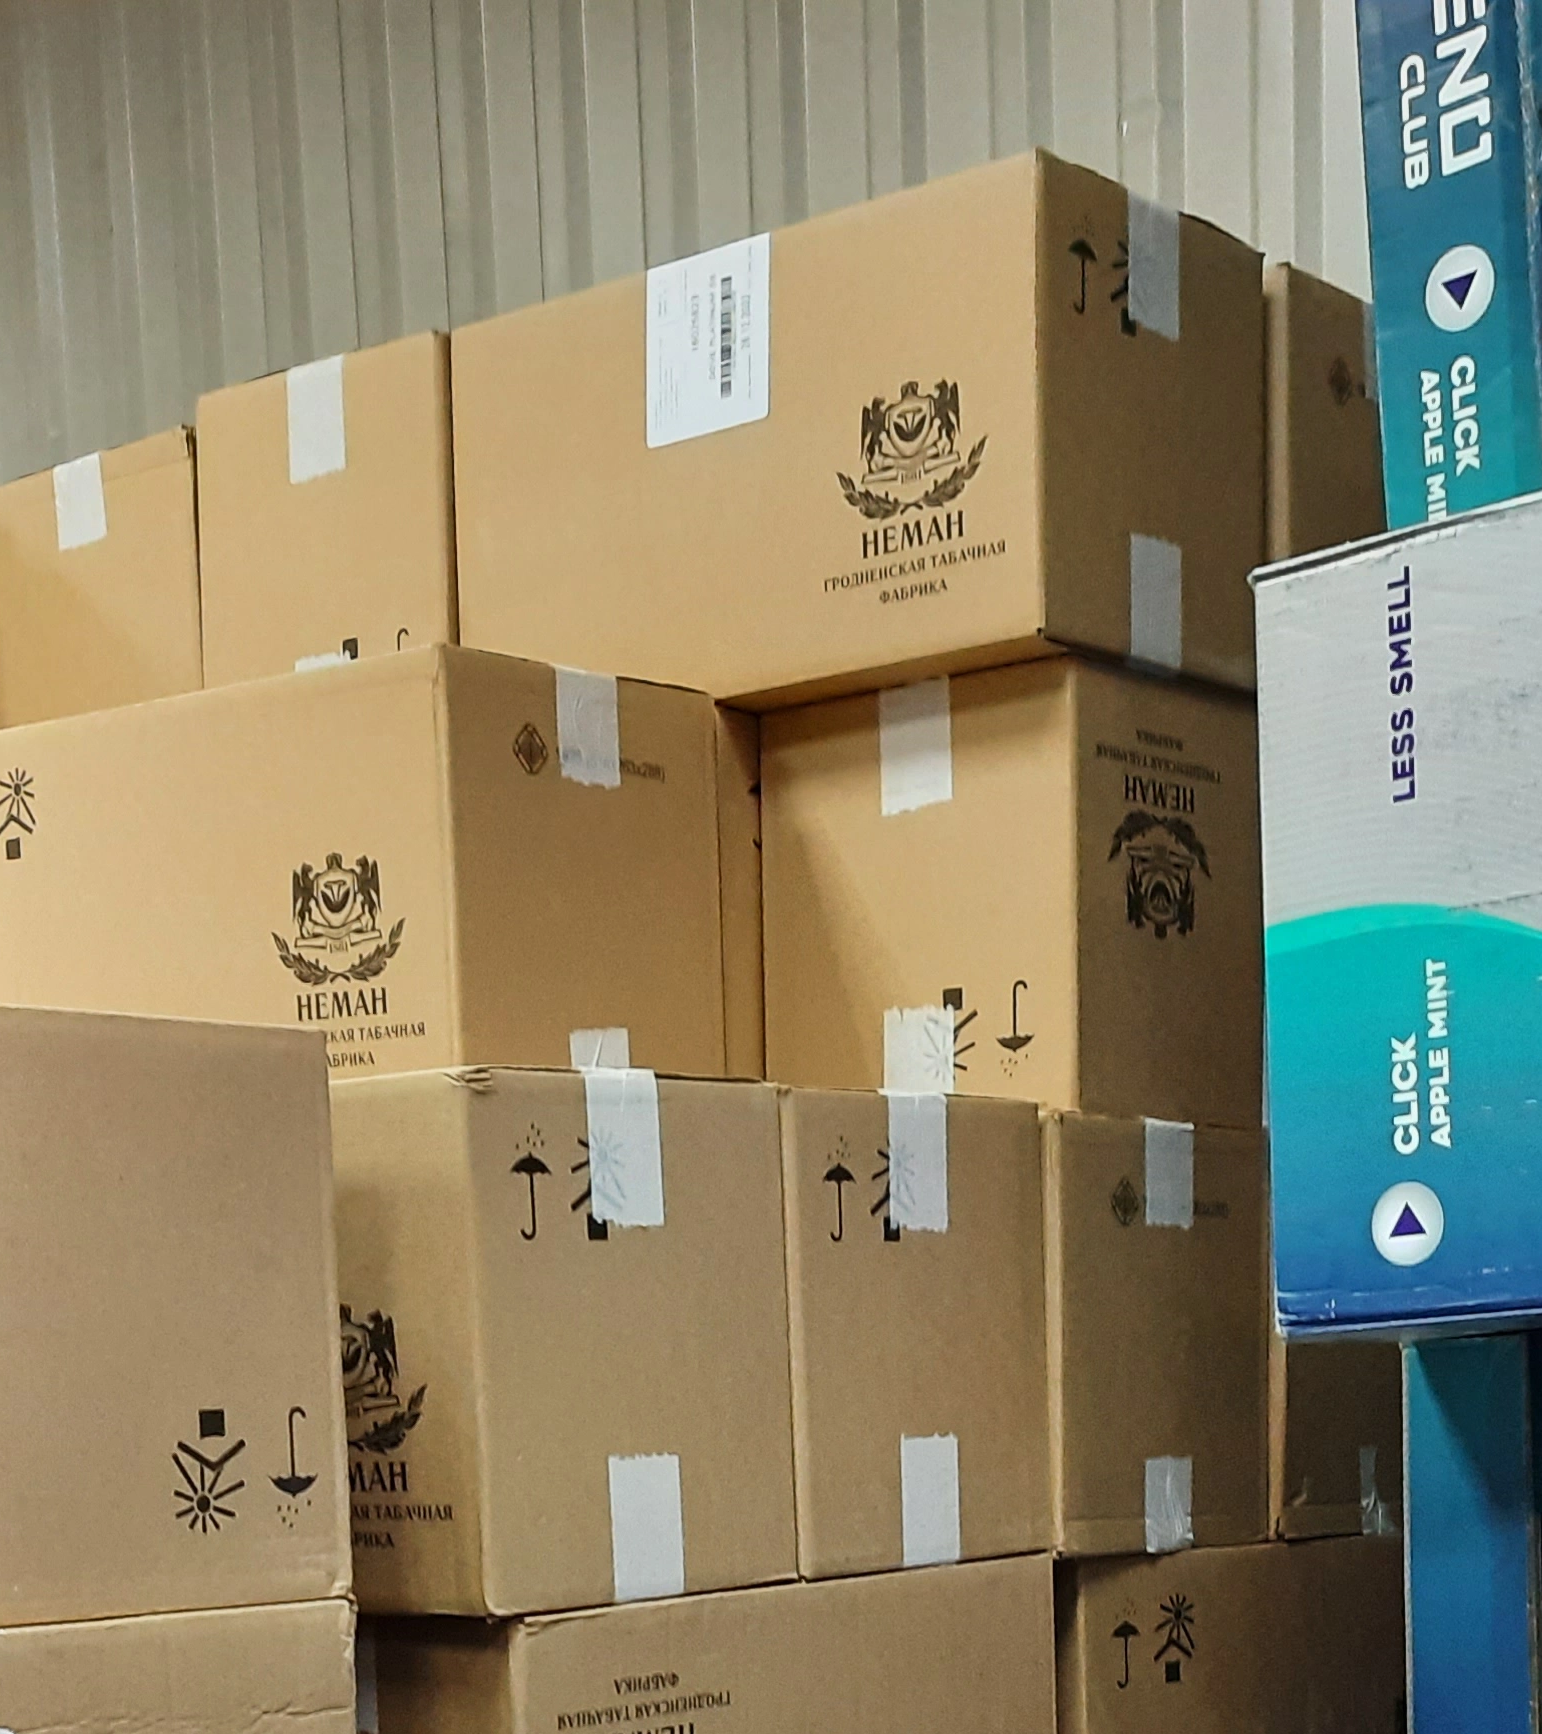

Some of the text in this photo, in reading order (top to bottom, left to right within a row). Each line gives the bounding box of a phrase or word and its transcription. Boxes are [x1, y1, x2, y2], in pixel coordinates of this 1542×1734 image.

[1399, 54, 1429, 189] CLUB
[1420, 369, 1444, 467] APPLE
[1450, 356, 1480, 477] CLICK
[861, 510, 965, 560] НЕМАН
[823, 539, 1007, 593] ГРОДНЕНСКАЯ ТАБАЧНАЯ
[879, 578, 949, 604] ФАБРИКА
[1388, 566, 1417, 802] LESS SMELL
[1123, 774, 1195, 814] НЕМАН
[296, 986, 389, 1022] НЕМАН
[360, 1021, 426, 1042] ТАБАЧНАЯ
[1424, 958, 1451, 1148] APPLE MINT
[327, 1050, 375, 1069] АБРИКА
[1392, 1035, 1418, 1155] CLICK
[348, 1461, 409, 1492] МАН
[613, 1671, 680, 1696] ФАБРИКА
[557, 1690, 732, 1732] ГРОДНЕНСКАЯ ТАБАЧНАЯ
